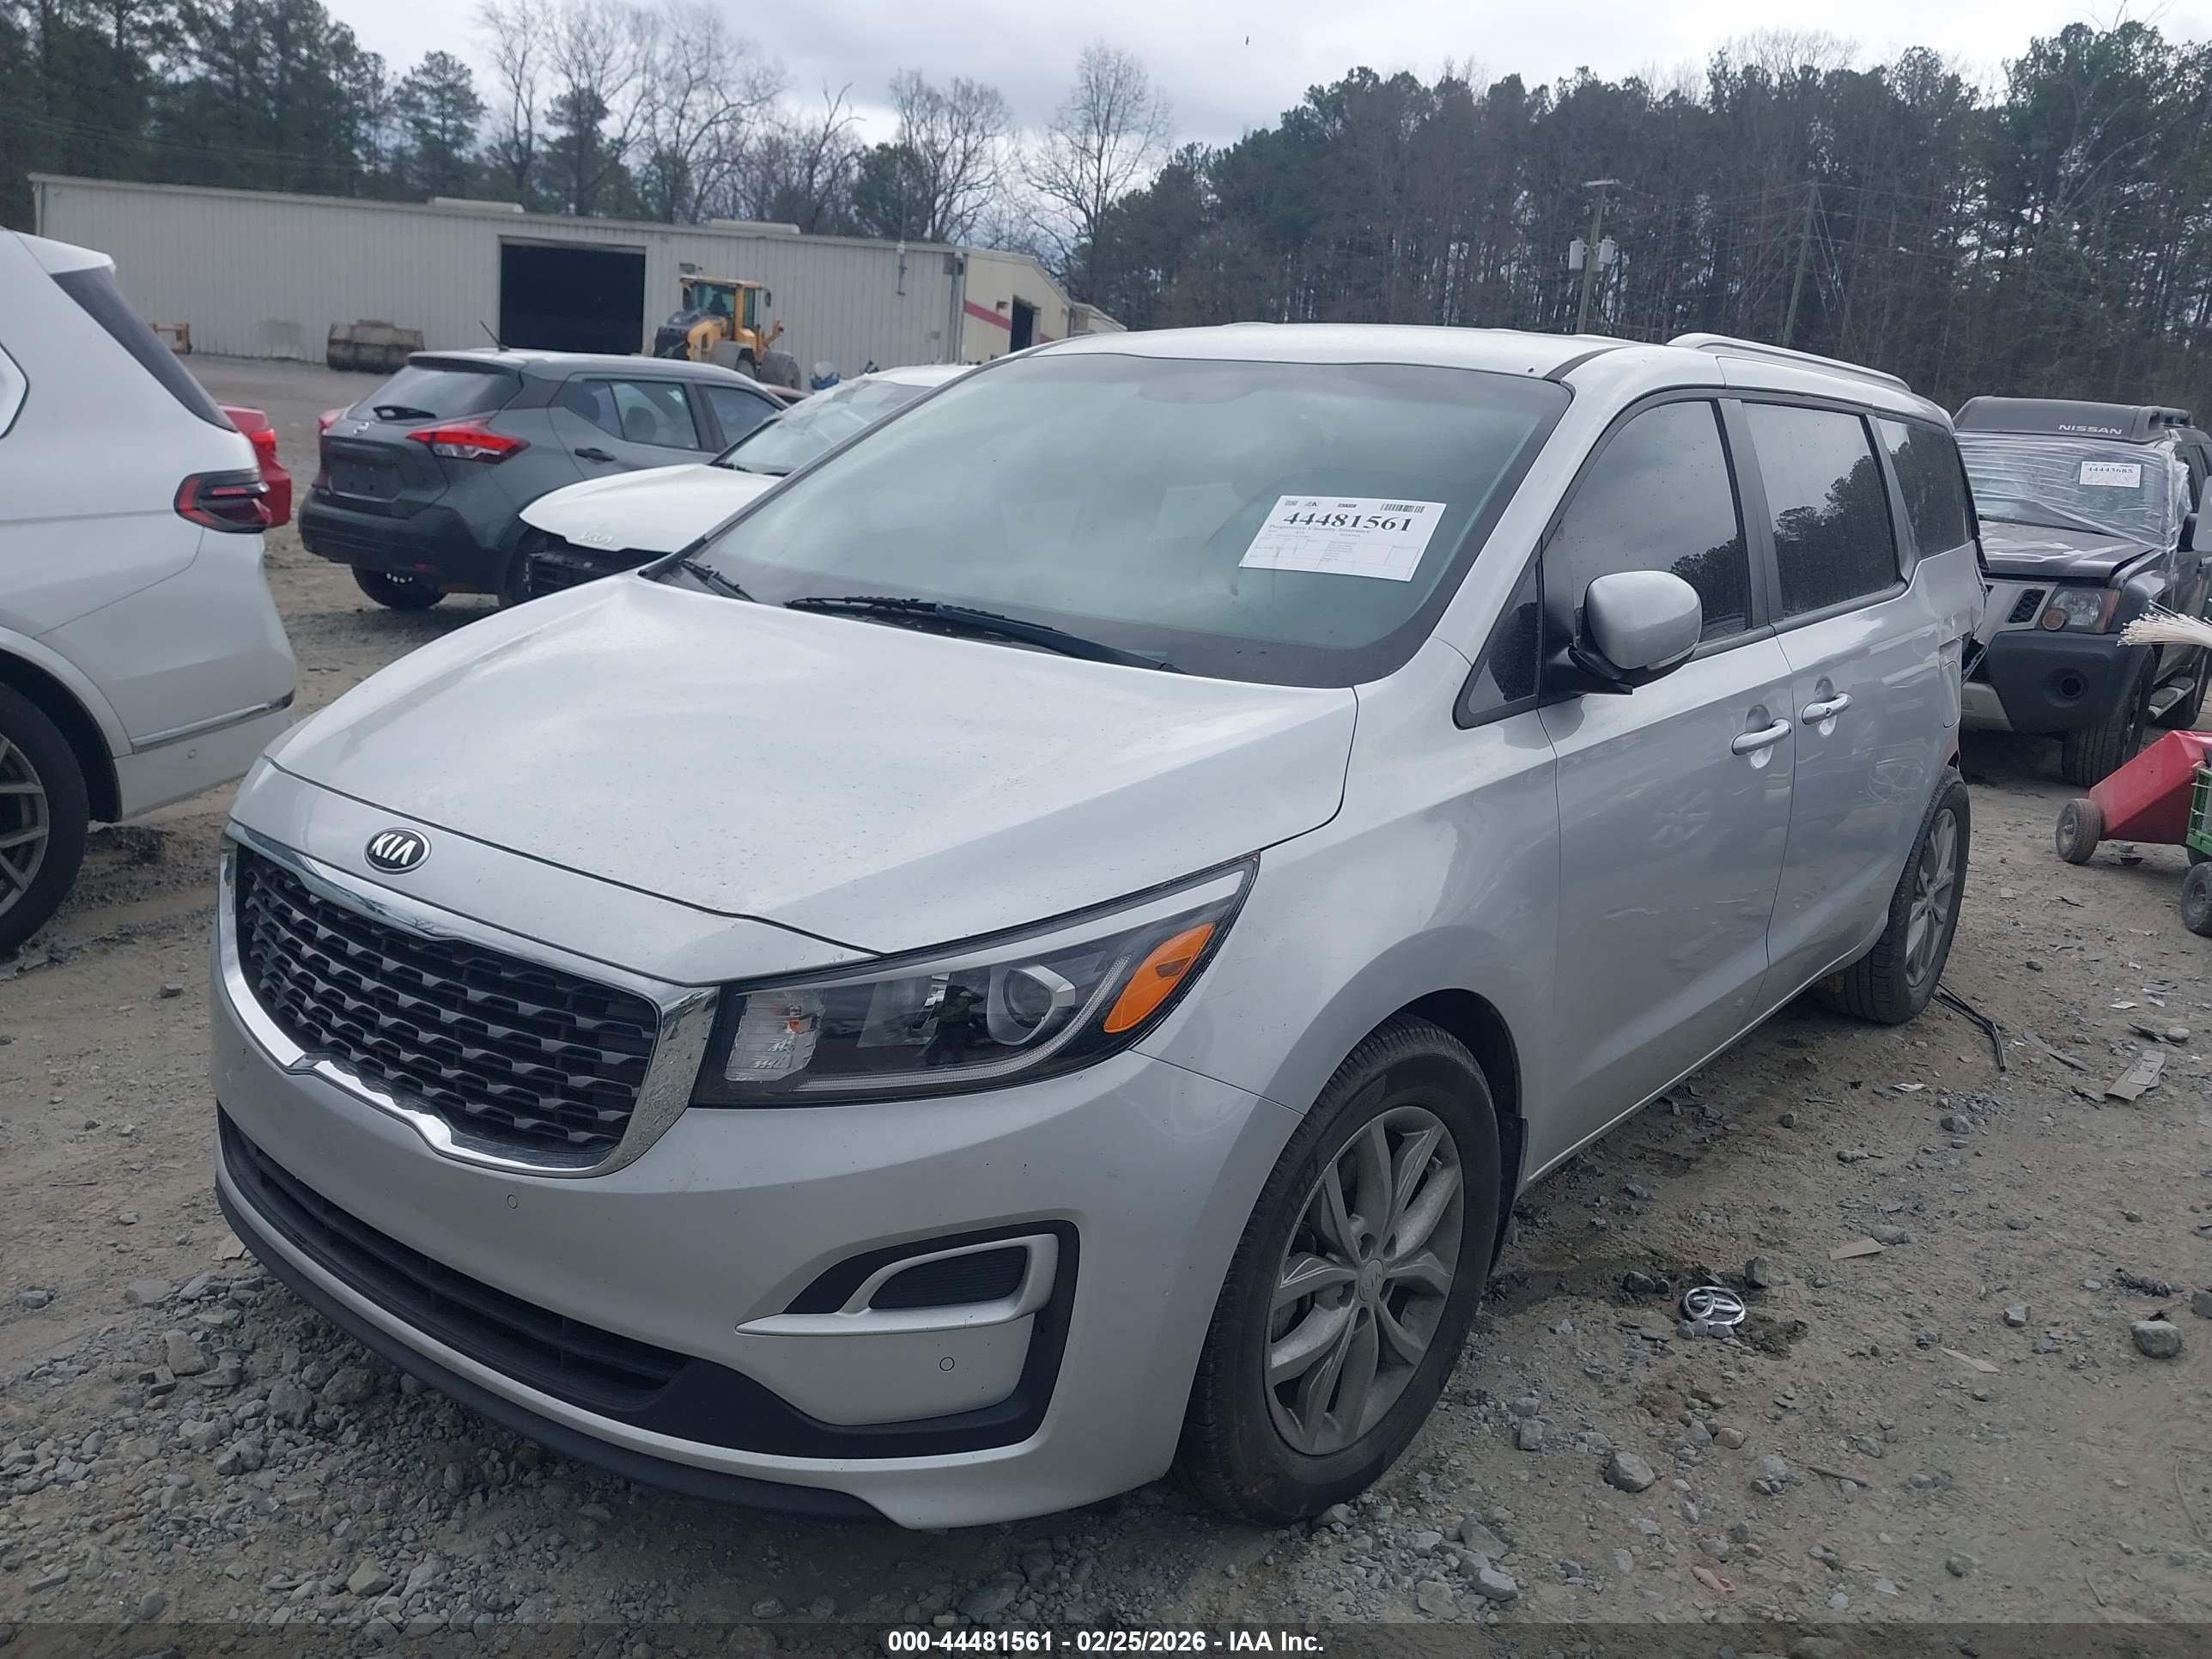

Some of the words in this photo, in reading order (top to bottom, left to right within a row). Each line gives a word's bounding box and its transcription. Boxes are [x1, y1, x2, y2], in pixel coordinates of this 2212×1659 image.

[2058, 424, 2123, 434] NISSAN
[1283, 512, 1413, 532] 44481561
[371, 832, 417, 866] KIA
